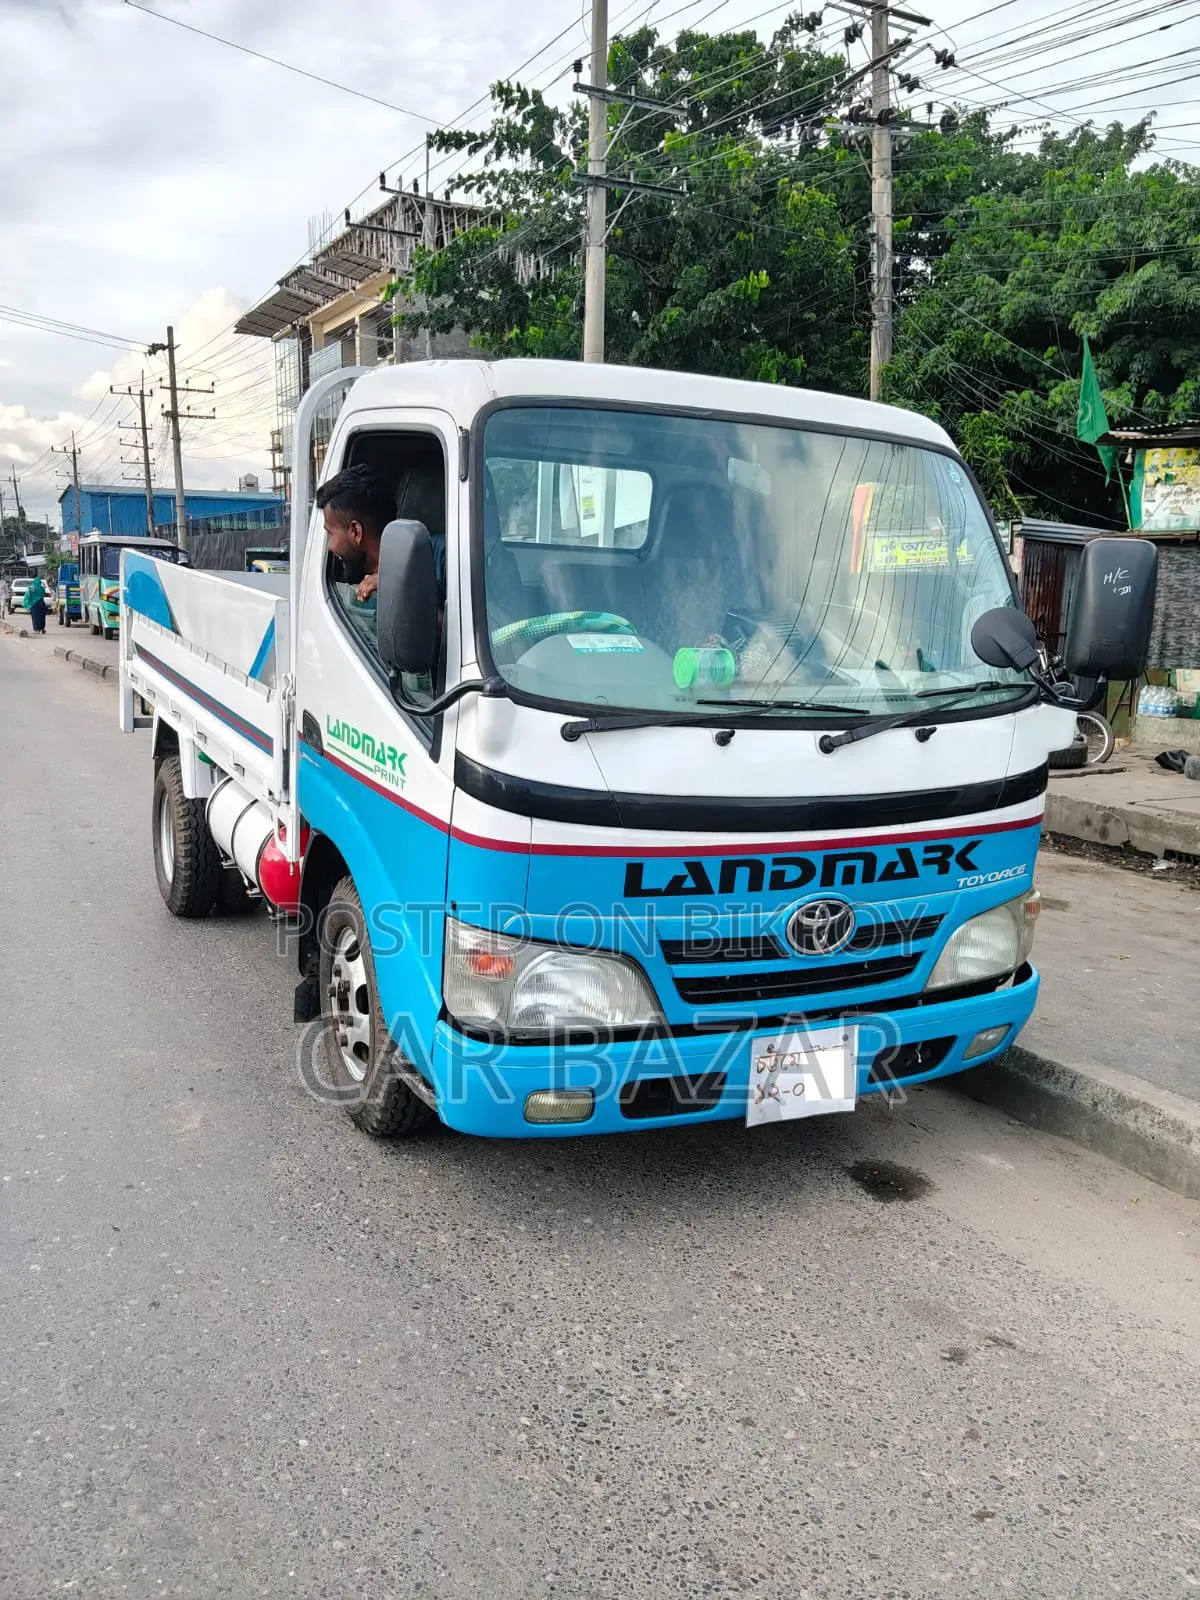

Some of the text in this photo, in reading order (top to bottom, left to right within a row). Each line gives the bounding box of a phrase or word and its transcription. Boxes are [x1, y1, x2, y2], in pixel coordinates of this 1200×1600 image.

[326, 712, 408, 777] LANDMARK
[373, 763, 407, 790] PRINT
[623, 840, 984, 898] LANDMARK
[957, 863, 1028, 889] TOYOACE
